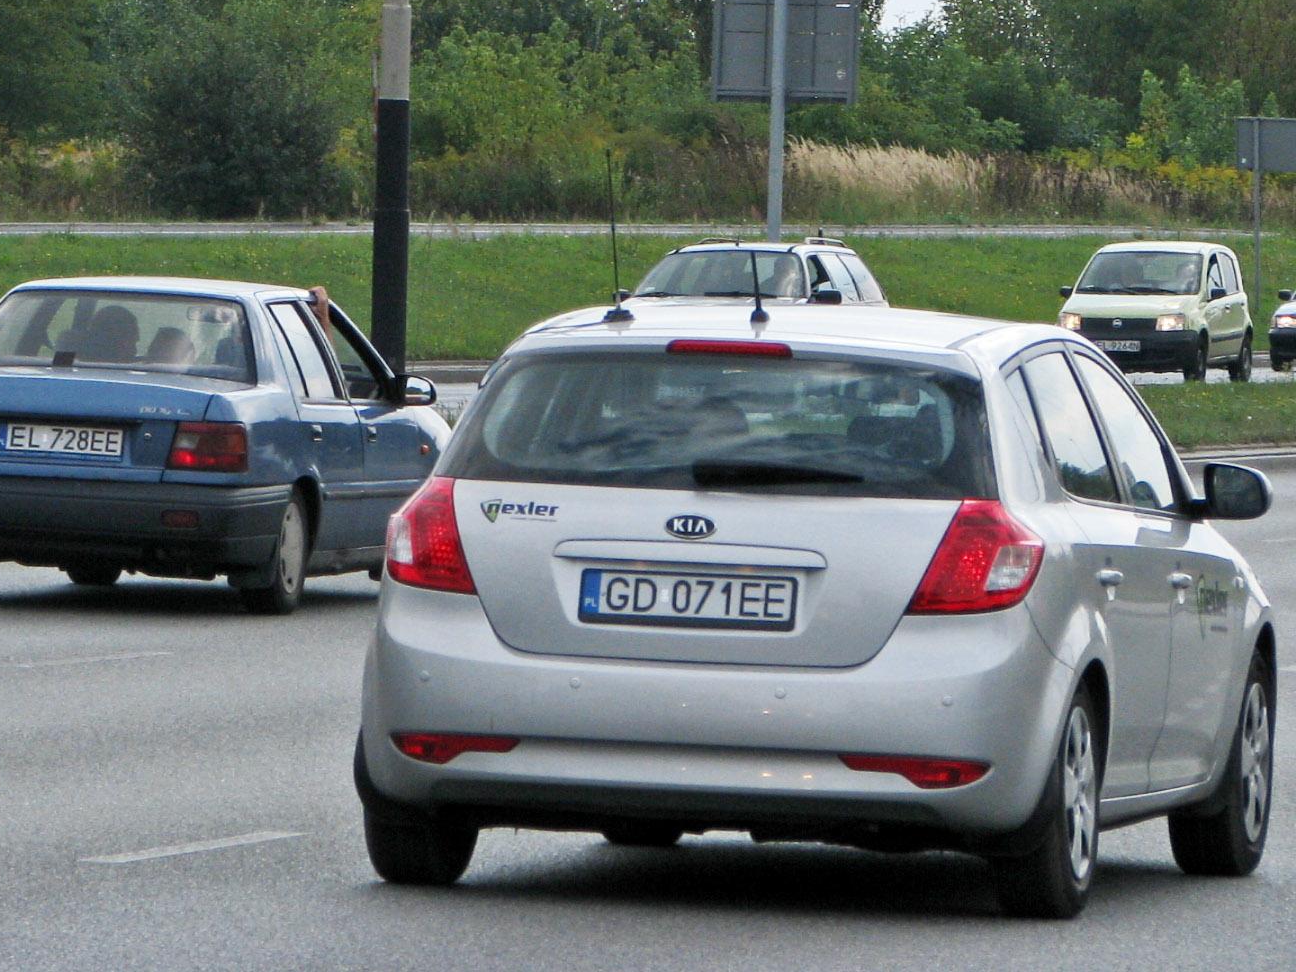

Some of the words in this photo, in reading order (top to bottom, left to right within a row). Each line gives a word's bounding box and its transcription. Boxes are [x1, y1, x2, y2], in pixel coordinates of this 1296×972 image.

[9, 426, 40, 448] EL
[49, 428, 120, 453] 728EE
[485, 500, 560, 517] nexler
[673, 518, 708, 533] KIA
[606, 577, 658, 613] GD
[671, 579, 787, 619] 071EE
